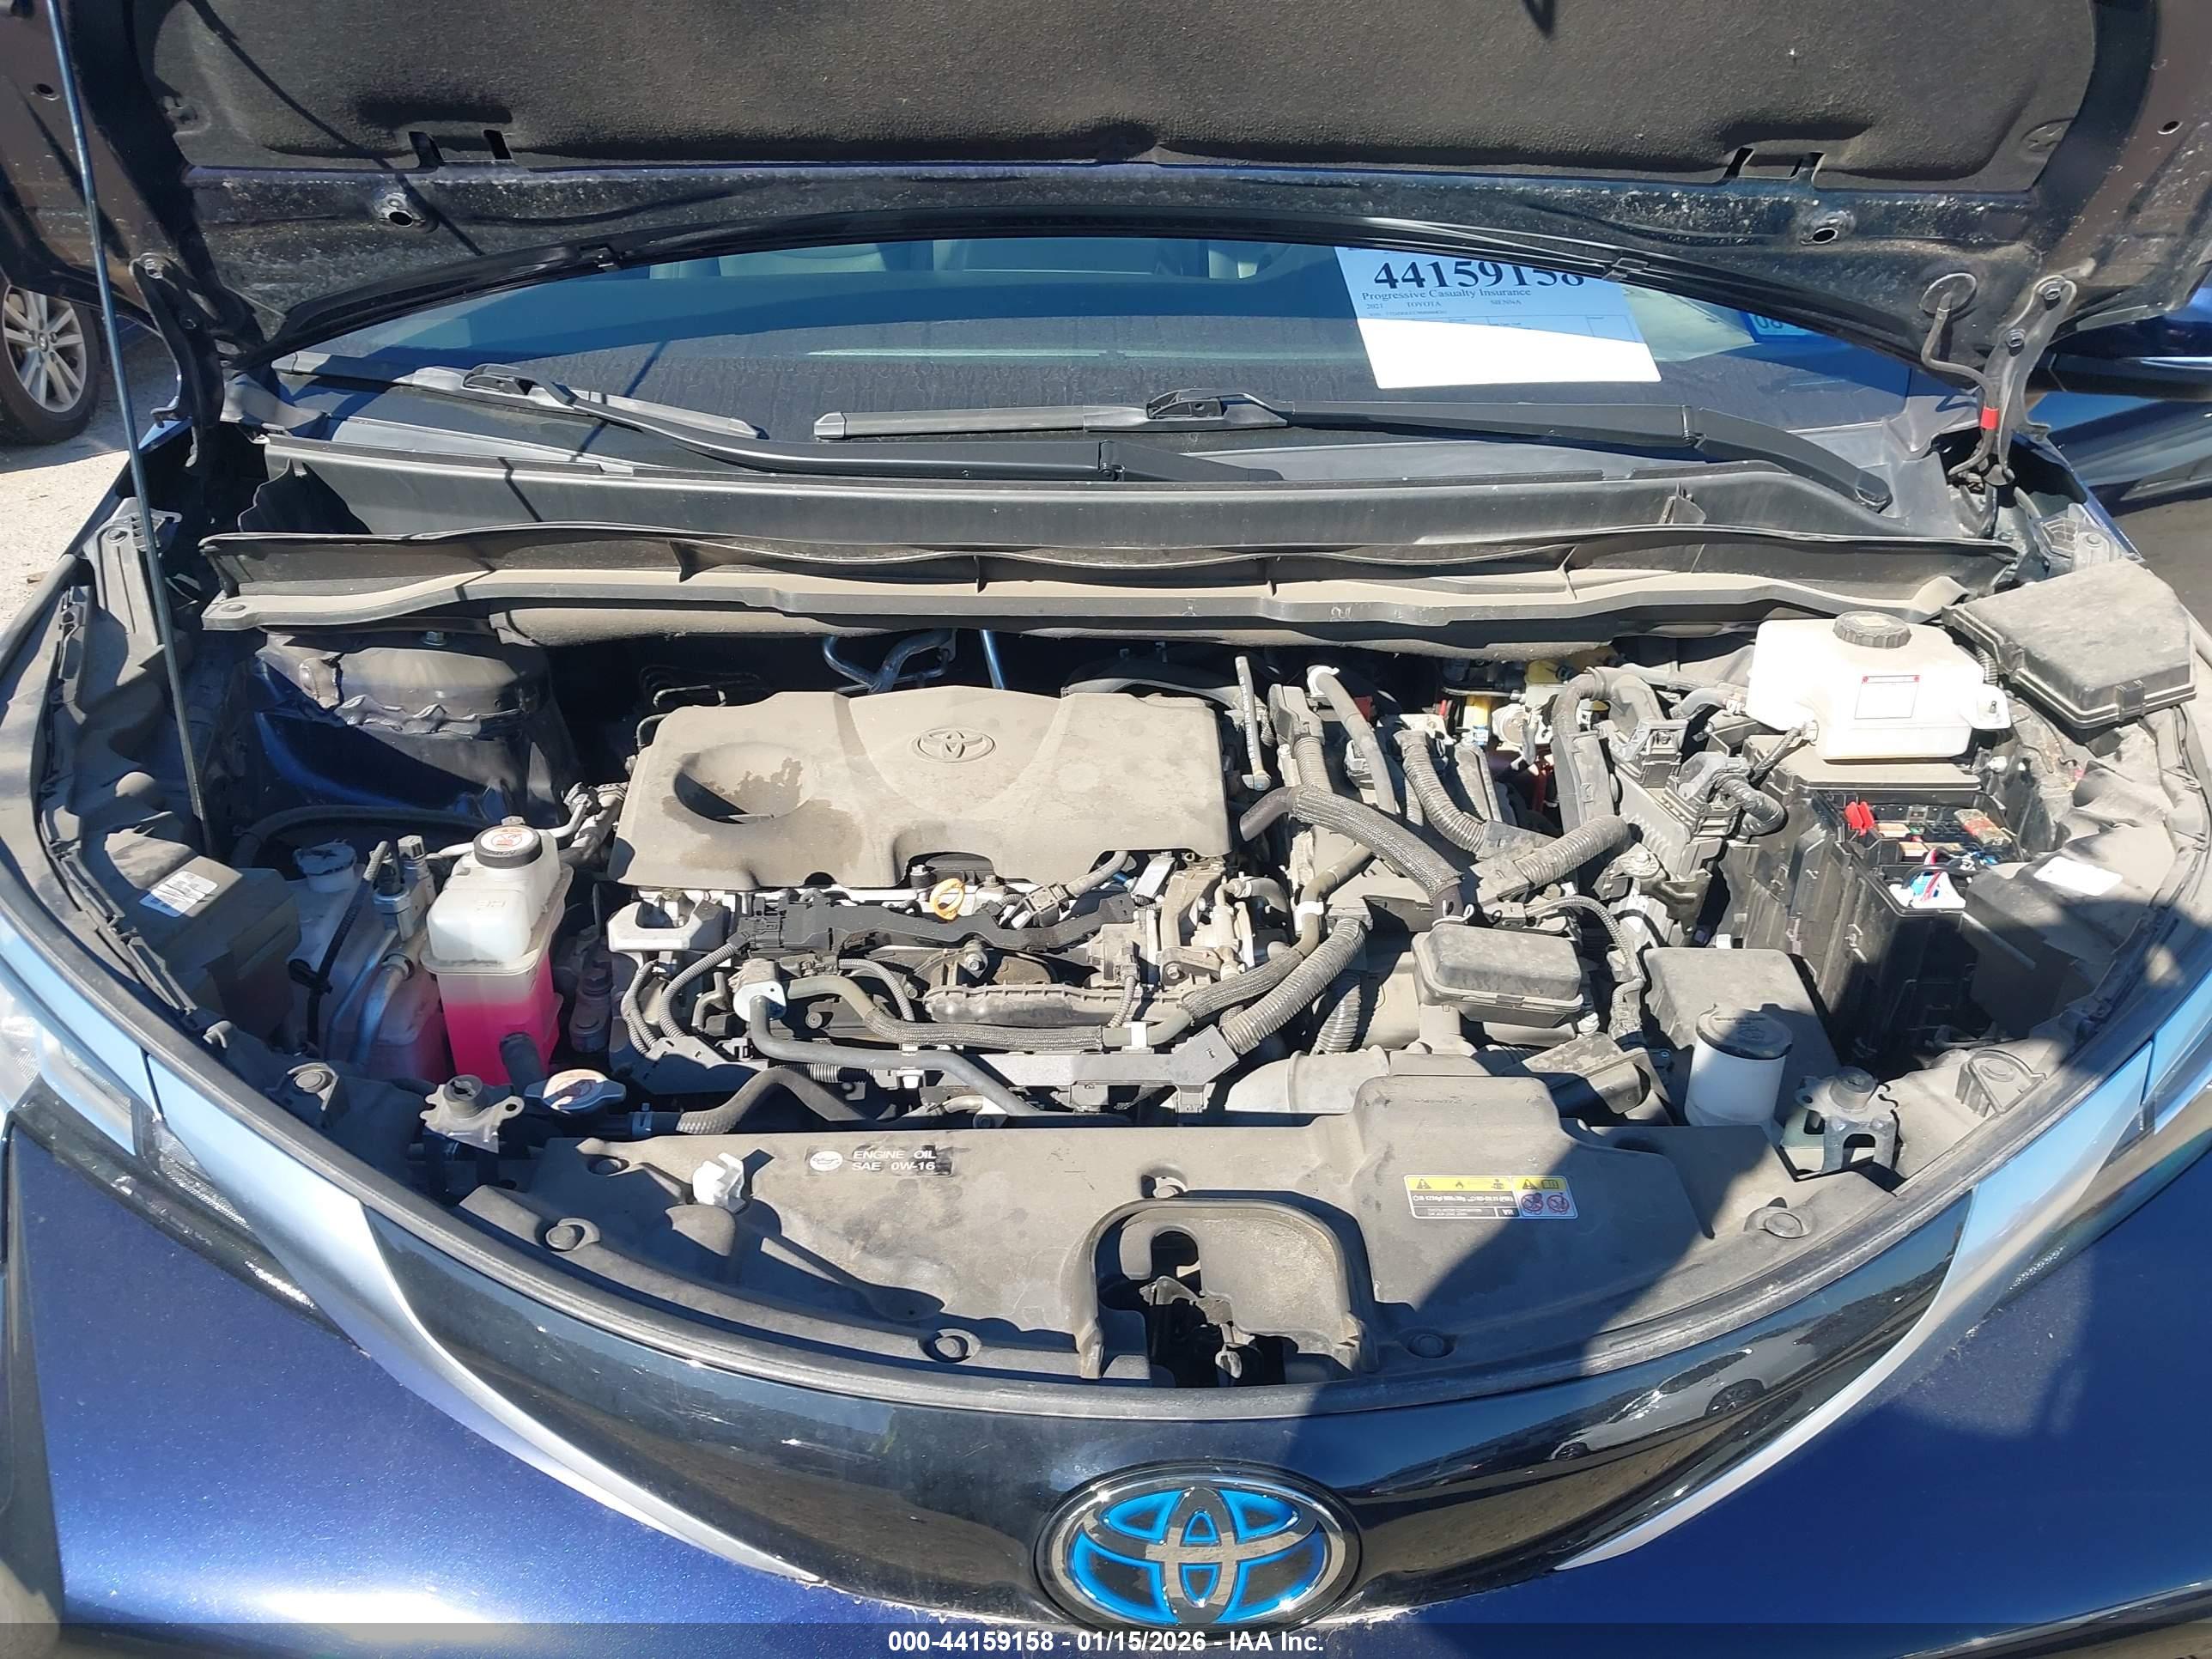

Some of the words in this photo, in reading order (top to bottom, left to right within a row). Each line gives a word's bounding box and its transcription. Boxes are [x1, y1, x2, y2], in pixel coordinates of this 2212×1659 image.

[1361, 289, 1426, 301] Progressive
[1428, 289, 1476, 300] Casualty
[1479, 288, 1532, 298] Insurance
[853, 1150, 905, 1159] ENGINE
[913, 1150, 937, 1159] OIL
[851, 1161, 882, 1171] SAE
[890, 1161, 936, 1171] 0W-16
